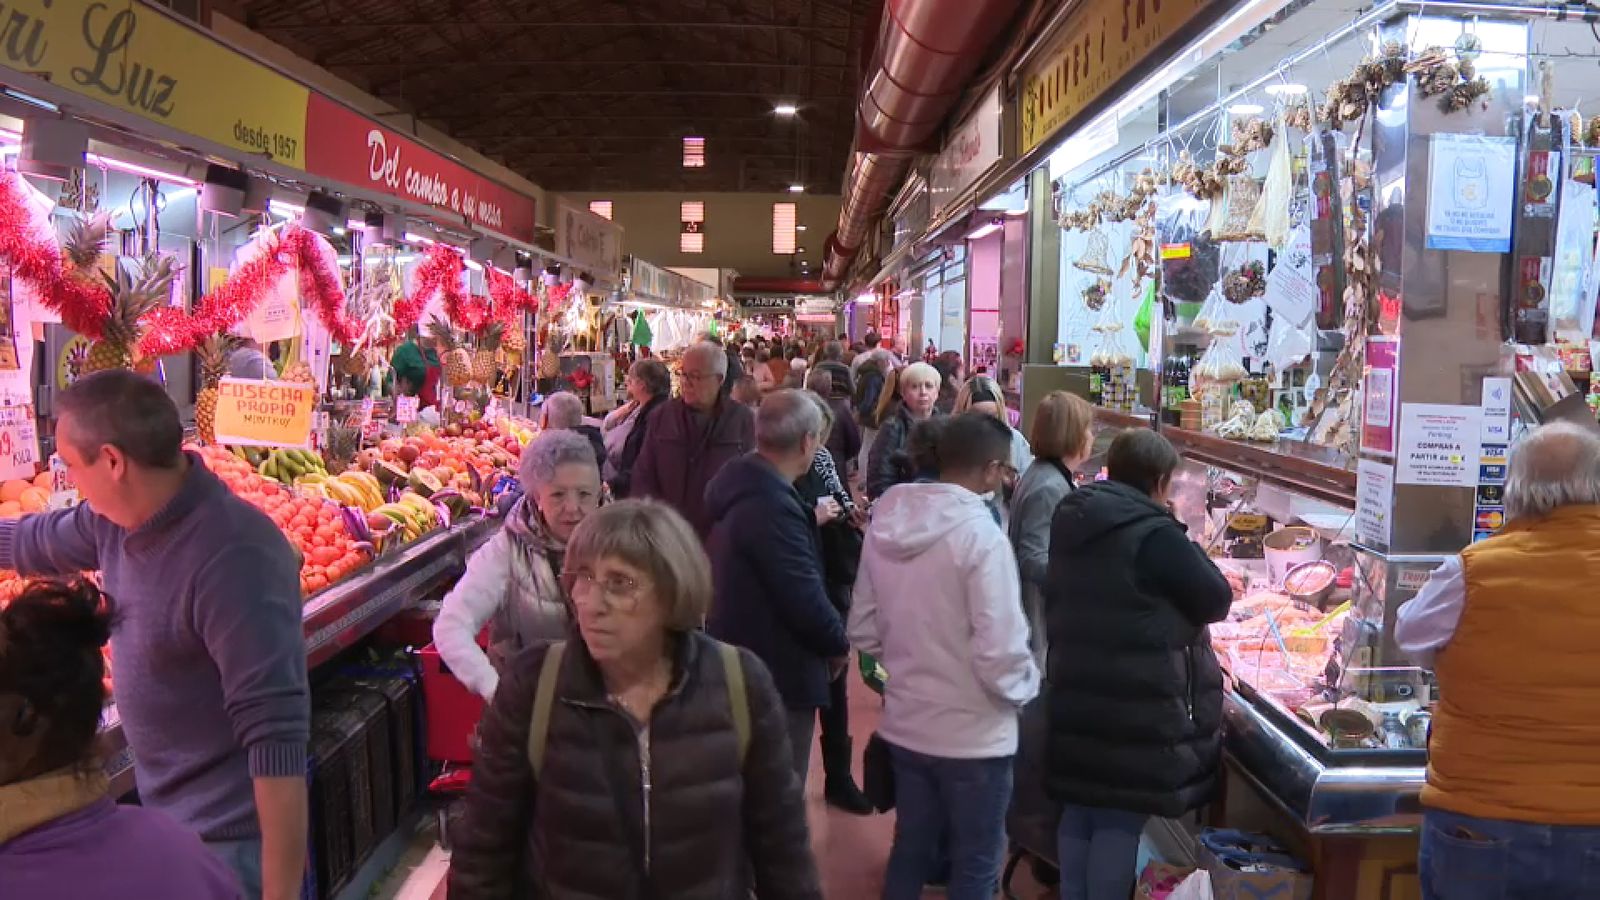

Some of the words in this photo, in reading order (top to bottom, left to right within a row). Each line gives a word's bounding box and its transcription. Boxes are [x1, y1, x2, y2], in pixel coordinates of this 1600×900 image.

[71, 3, 178, 117] Luz
[1040, 33, 1090, 117] OLIVES
[233, 118, 269, 153] desde
[272, 132, 297, 161] 1957
[367, 129, 400, 188] Del
[404, 167, 448, 205] campo
[451, 187, 461, 212] a
[479, 200, 503, 228] mesa
[219, 382, 303, 402] COSECHA
[236, 400, 295, 418] PROPIA
[1410, 452, 1438, 460] PARTIR
[1417, 442, 1454, 450] COMPRAS
